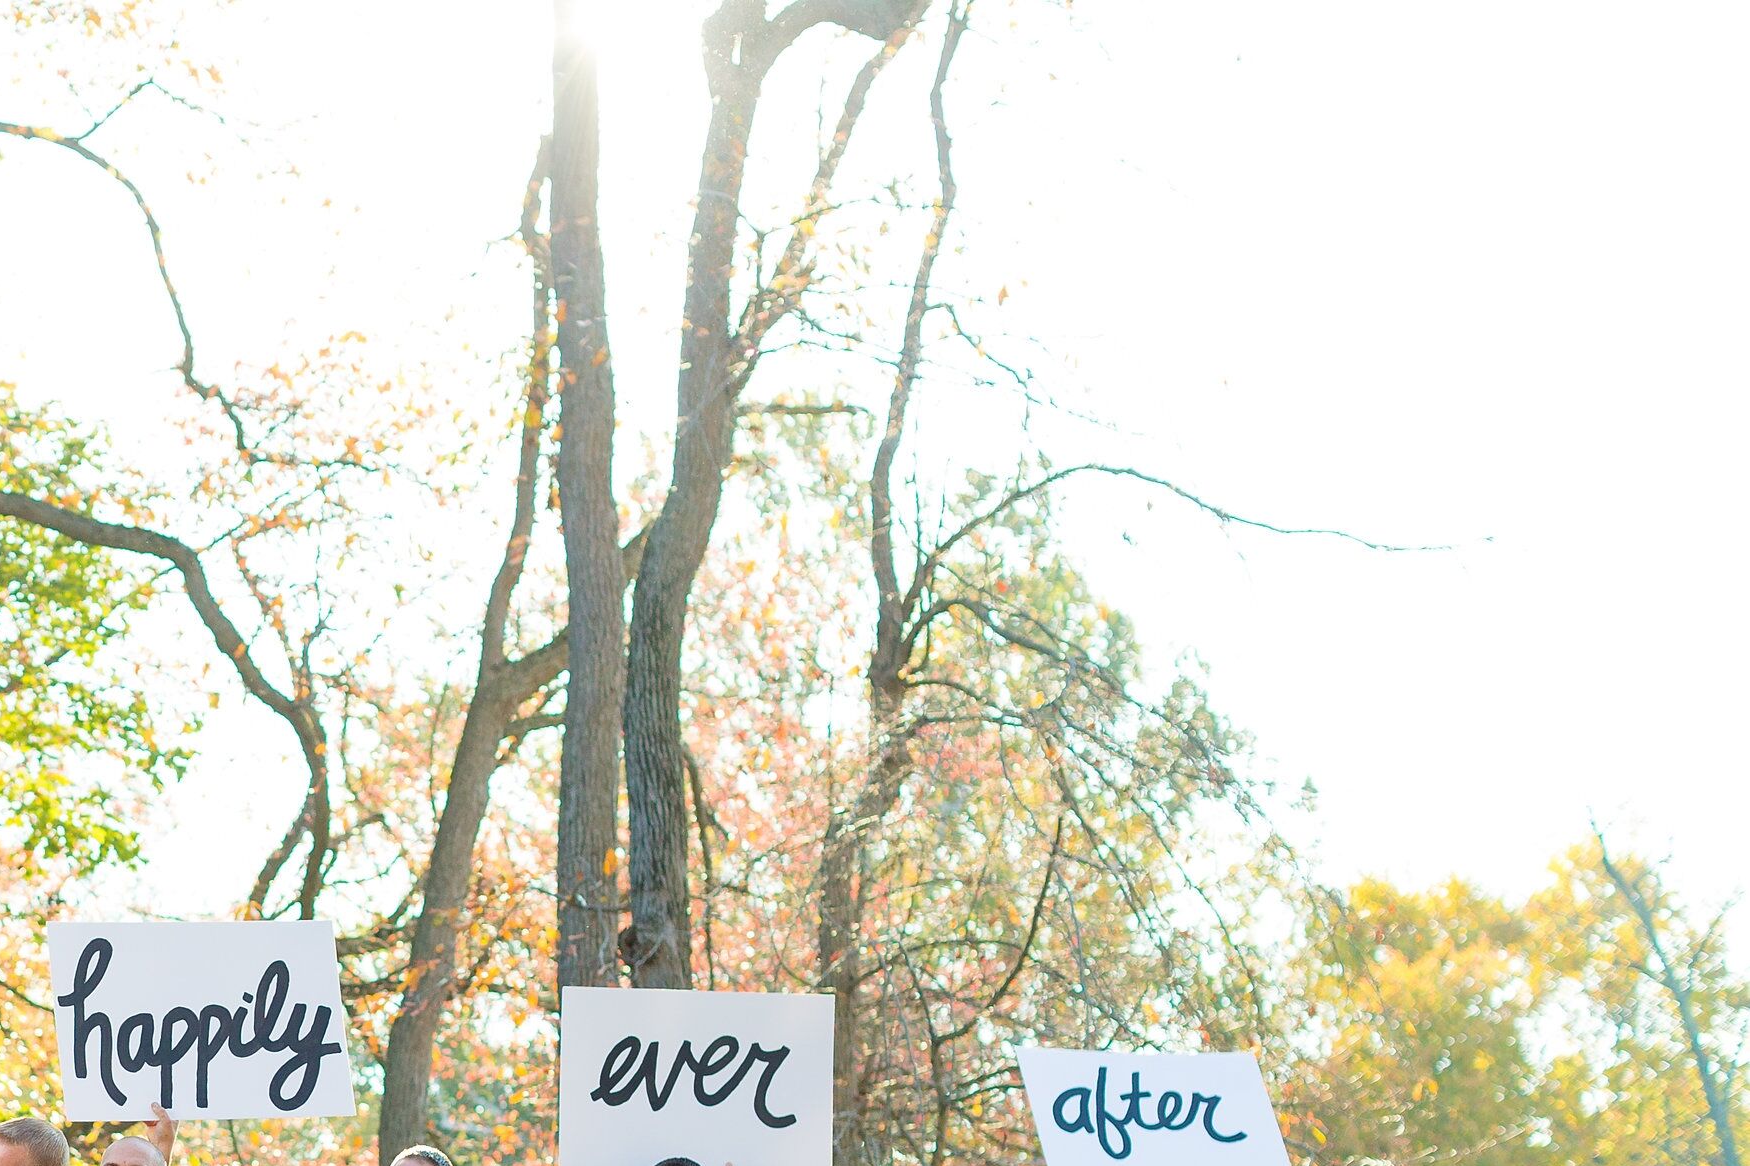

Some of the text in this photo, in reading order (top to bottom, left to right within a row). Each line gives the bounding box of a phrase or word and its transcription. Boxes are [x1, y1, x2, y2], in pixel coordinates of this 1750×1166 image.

[58, 938, 342, 1111] happily
[590, 1036, 796, 1128] ever
[1053, 1067, 1247, 1159] after
